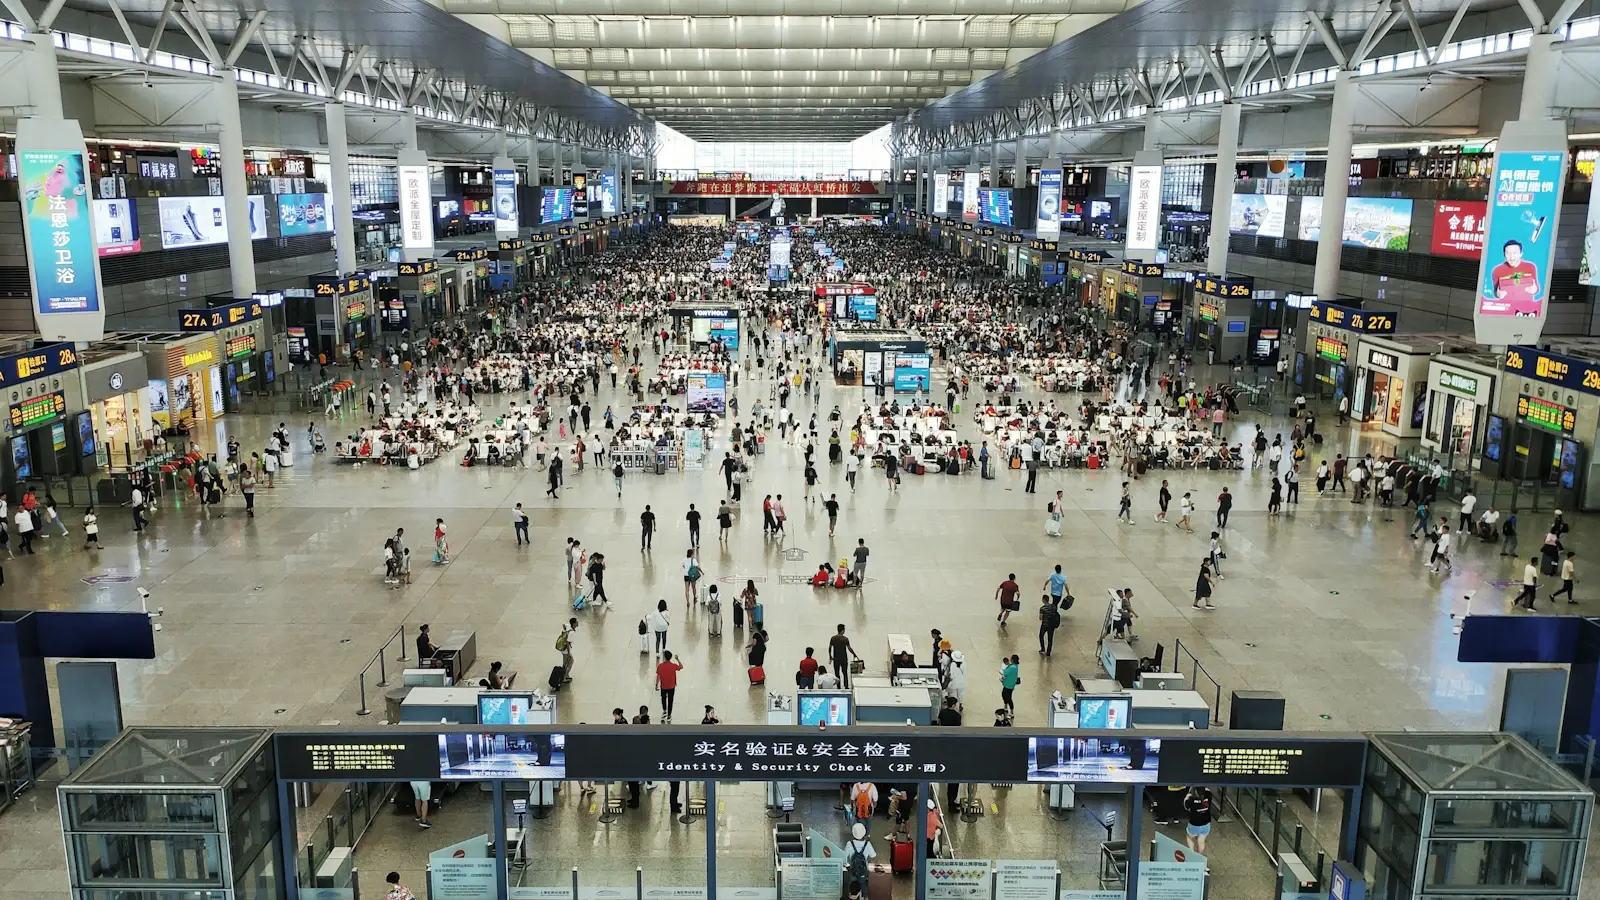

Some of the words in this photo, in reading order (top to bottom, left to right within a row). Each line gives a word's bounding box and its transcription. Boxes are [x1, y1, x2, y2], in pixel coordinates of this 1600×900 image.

[408, 178, 422, 241] 欧派全屋定制
[1136, 179, 1150, 242] 欧派全屋定制
[48, 194, 75, 284] 法恩莎卫浴
[456, 251, 470, 260] 21A
[400, 265, 415, 274] 23A
[1146, 266, 1161, 275] 23B
[317, 284, 335, 294] 25A
[1231, 286, 1249, 296] 25B
[184, 313, 207, 327] 27A
[1352, 314, 1363, 328] 27B
[1367, 316, 1392, 329] 27B
[59, 349, 76, 365] 28A
[1506, 351, 1523, 369] 28B
[694, 741, 911, 757] 实名验证&安全检查
[658, 762, 726, 772] Identity
[734, 762, 743, 771] &
[751, 762, 820, 772] Security
[829, 762, 872, 772] Check
